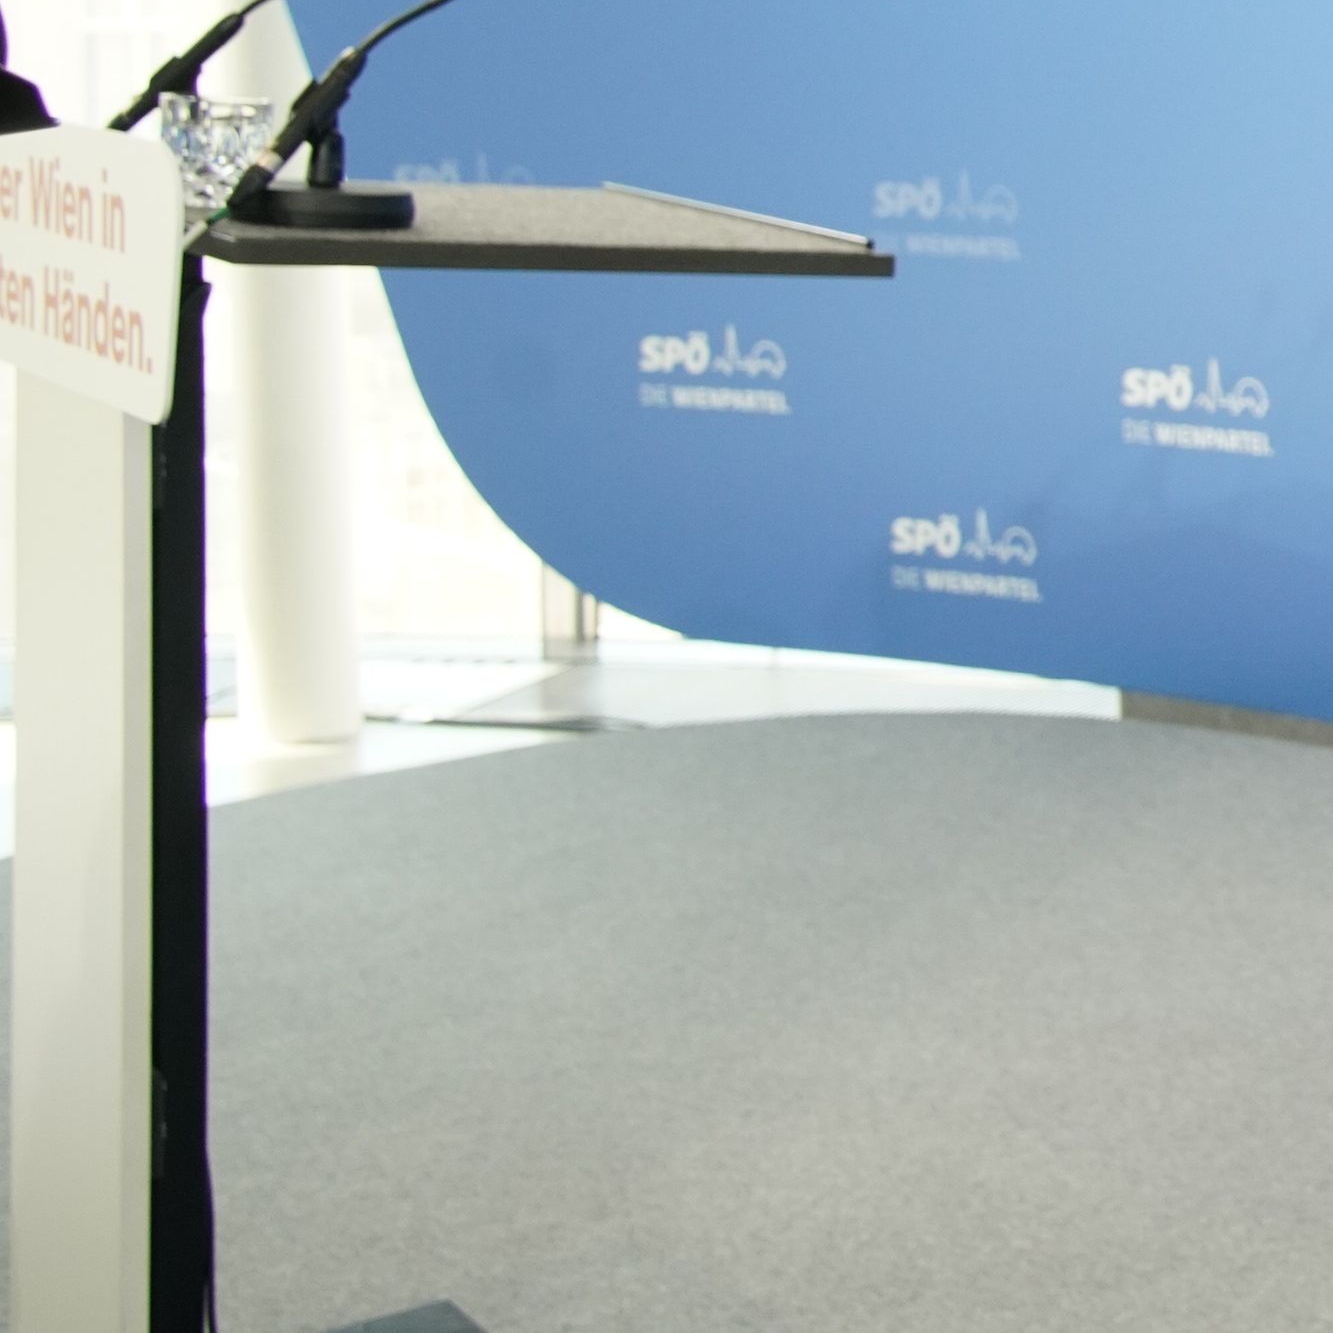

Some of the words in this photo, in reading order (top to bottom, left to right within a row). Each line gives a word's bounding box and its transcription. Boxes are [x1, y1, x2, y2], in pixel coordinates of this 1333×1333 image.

[29, 156, 94, 243] Wien
[102, 168, 125, 253] in
[43, 264, 154, 374] Händen.
[640, 330, 710, 375] SPÖ
[1121, 364, 1193, 410] SPÖ
[891, 513, 961, 558] SPÖ
